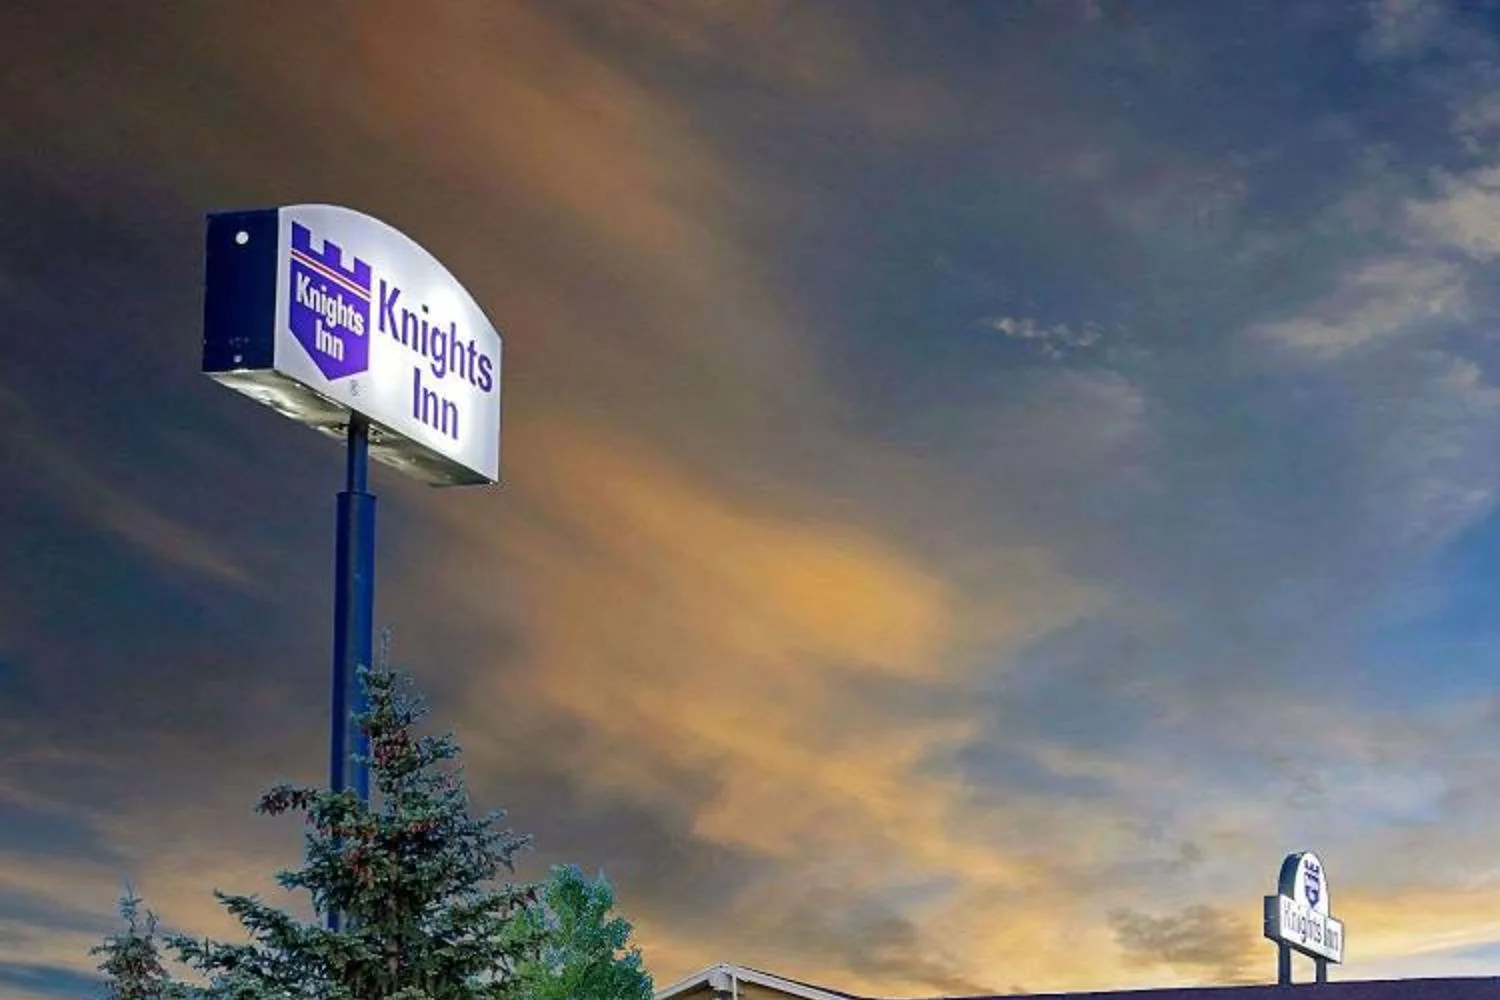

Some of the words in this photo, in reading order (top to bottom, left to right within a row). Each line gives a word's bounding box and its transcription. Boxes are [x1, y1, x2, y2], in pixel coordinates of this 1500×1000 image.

[295, 271, 365, 337] Knights
[378, 279, 493, 393] Knights
[314, 319, 344, 362] Inn
[412, 366, 459, 440] Inn
